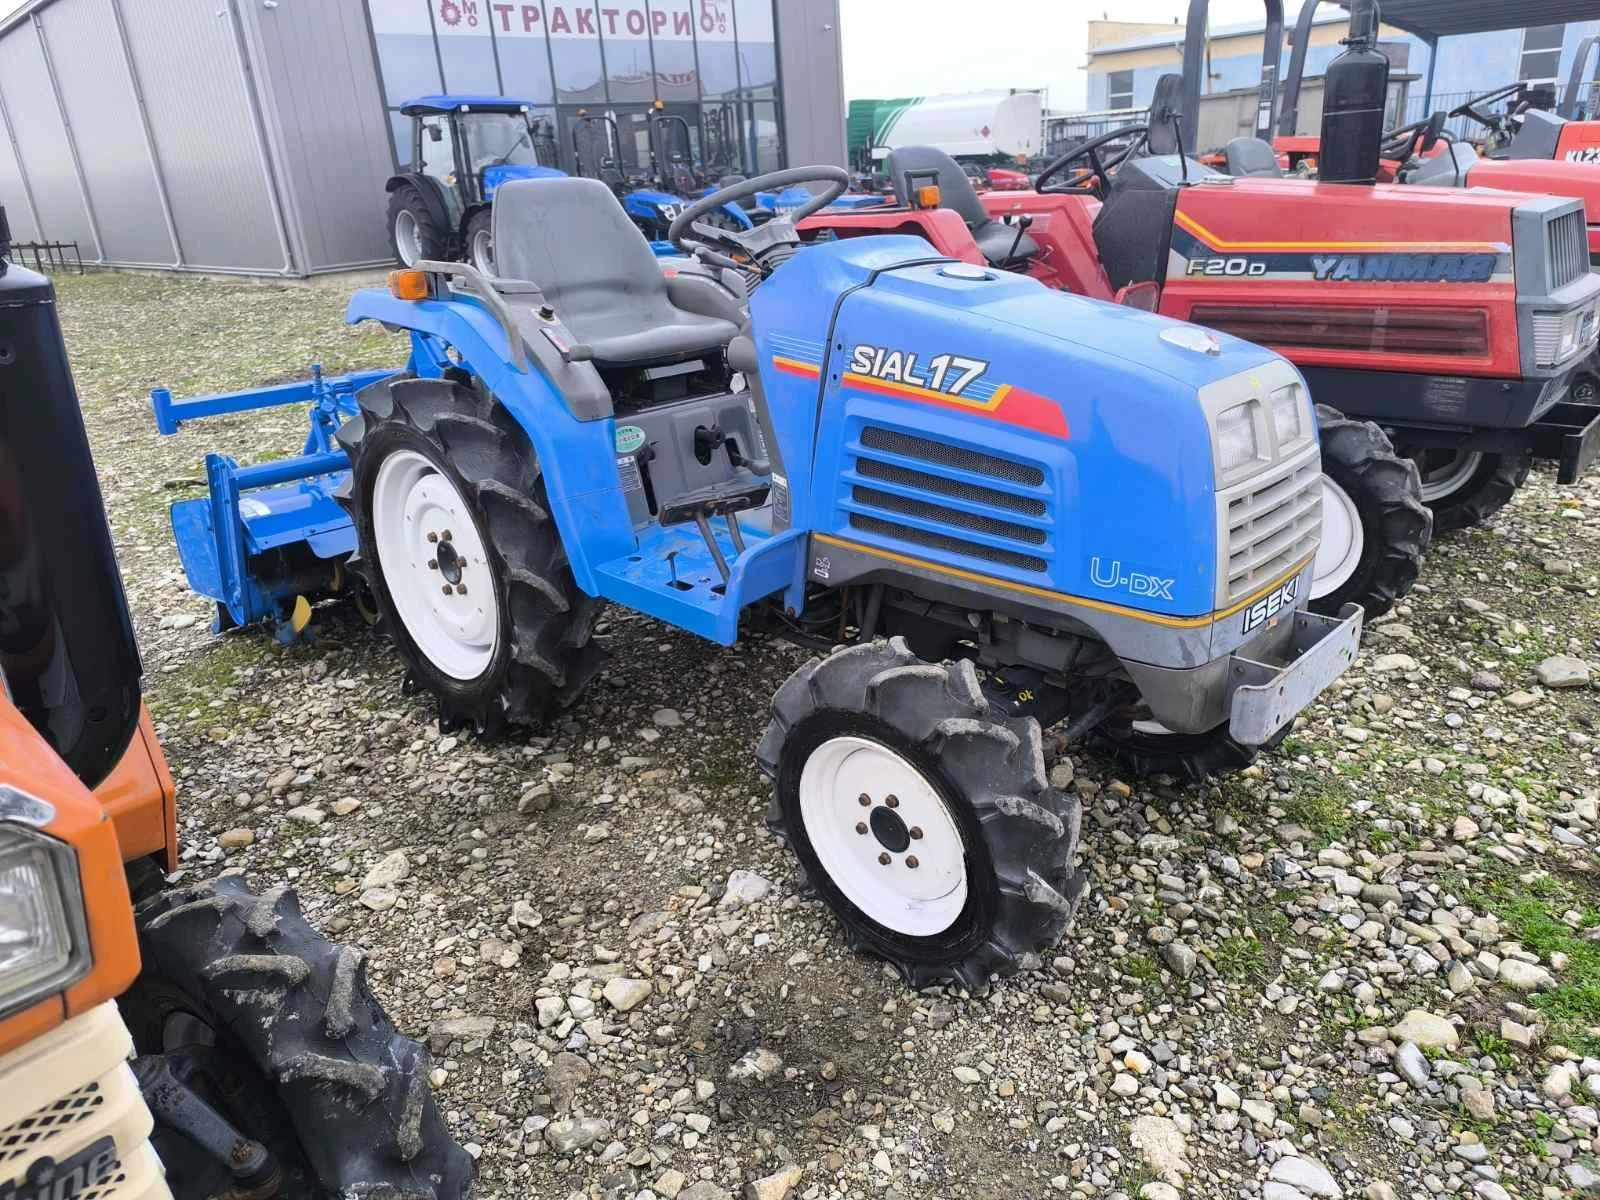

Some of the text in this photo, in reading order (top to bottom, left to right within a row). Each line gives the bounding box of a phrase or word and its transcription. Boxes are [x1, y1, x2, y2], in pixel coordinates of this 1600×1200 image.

[493, 3, 692, 36] ТРАКТОРИ
[1312, 254, 1496, 282] YANMAR
[1242, 574, 1300, 636] ISEKI
